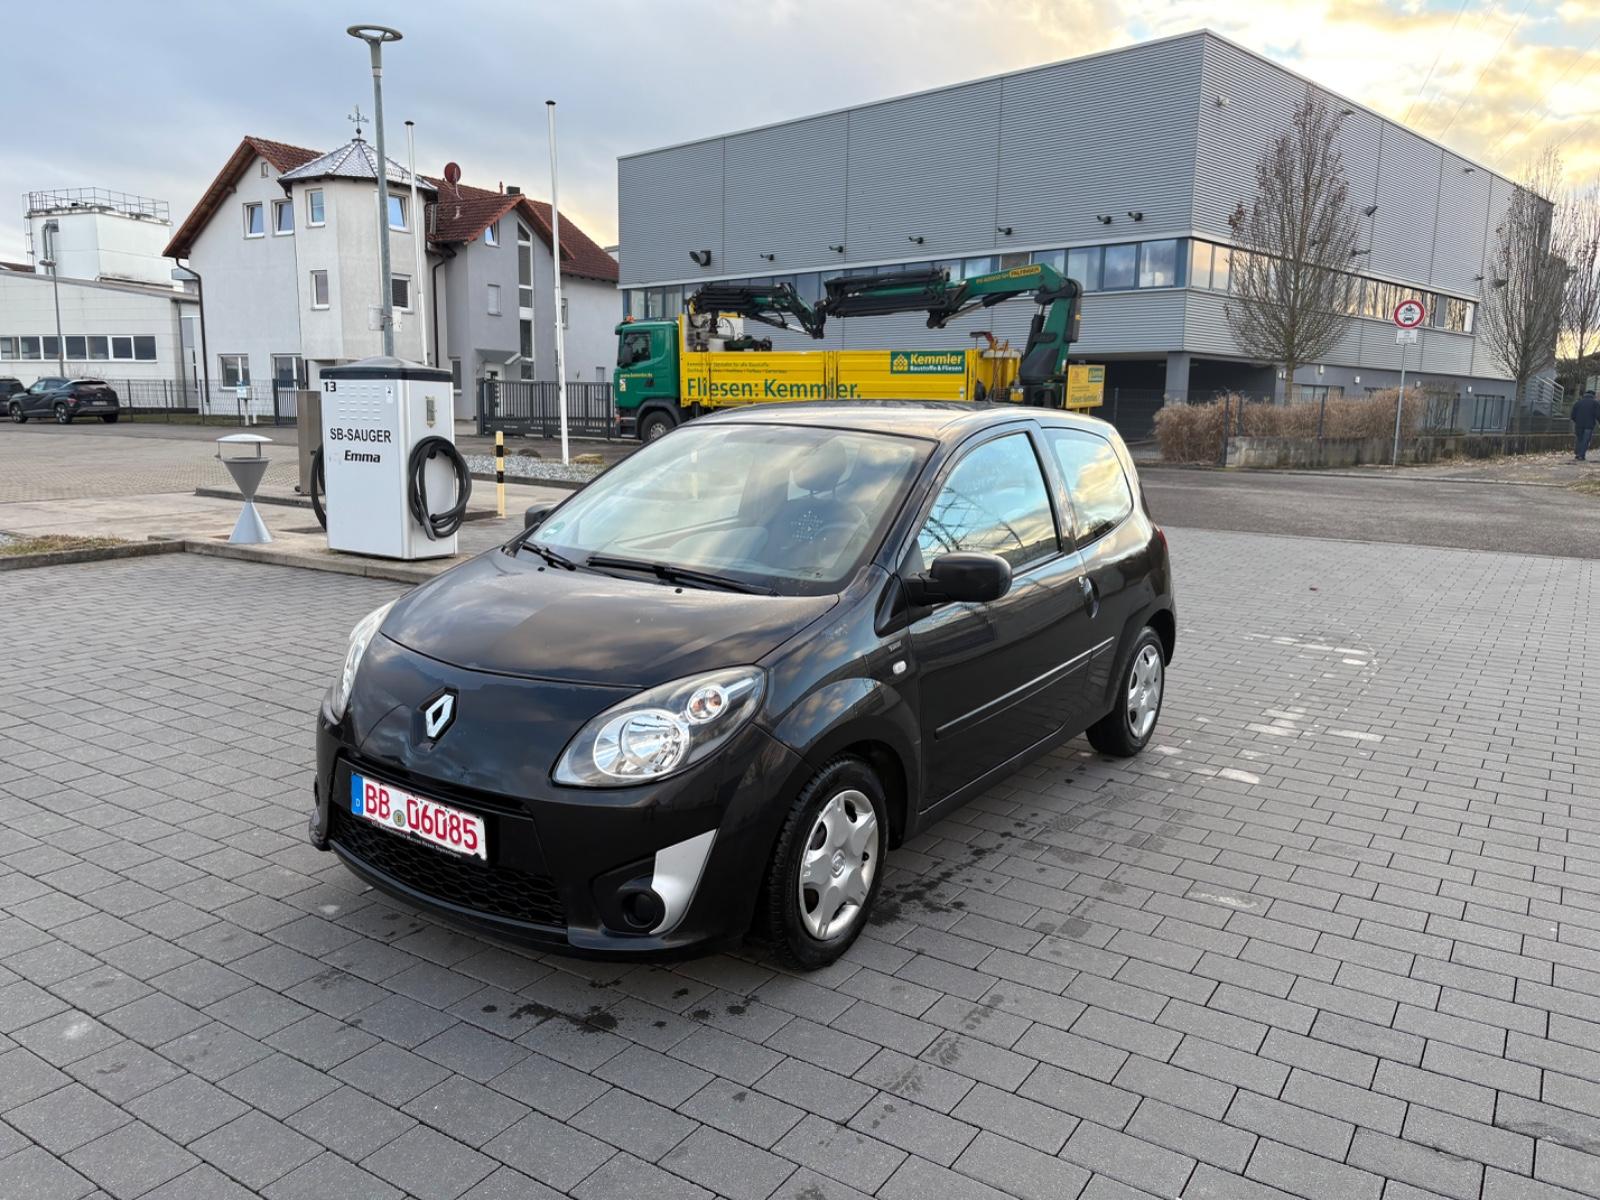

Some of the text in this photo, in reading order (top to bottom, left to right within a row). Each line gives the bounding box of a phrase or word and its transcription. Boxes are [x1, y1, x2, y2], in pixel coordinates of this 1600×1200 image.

[910, 353, 963, 365] Kemmler
[324, 381, 337, 392] 13
[687, 377, 861, 399] Fliesen: Kemmler.
[330, 427, 392, 443] SB-SAUGER
[344, 450, 381, 463] Emma
[365, 783, 391, 820] BB
[407, 799, 478, 850] 06085
